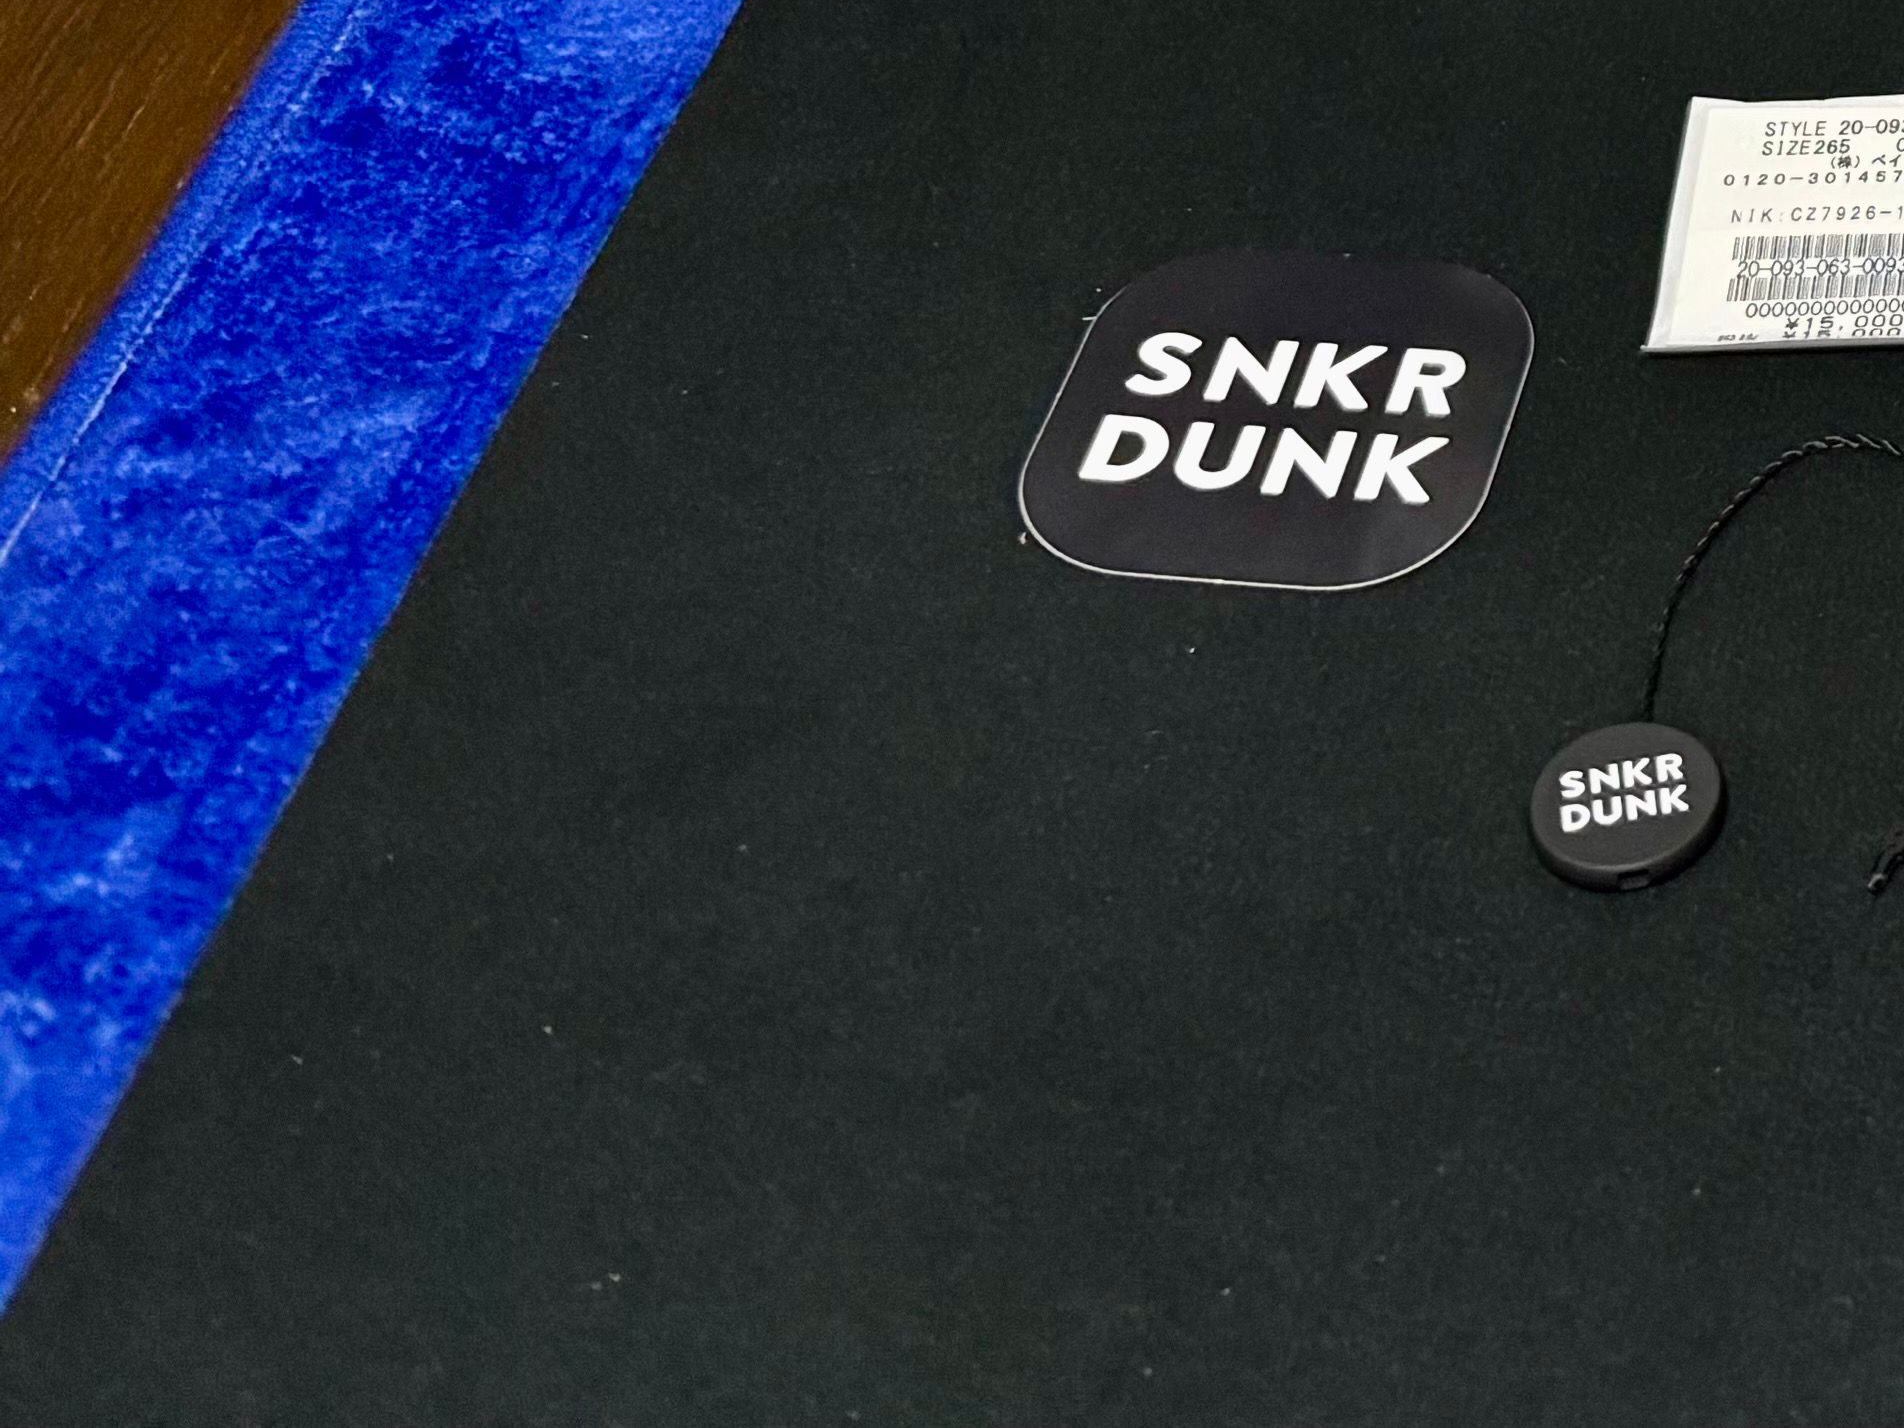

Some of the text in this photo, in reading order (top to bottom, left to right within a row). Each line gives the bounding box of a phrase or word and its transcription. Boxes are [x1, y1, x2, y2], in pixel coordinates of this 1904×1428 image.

[1765, 120, 1827, 137] STYLE
[1125, 331, 1467, 418] SNKR
[1078, 413, 1450, 505] DUNK
[1558, 752, 1684, 799] SNKR
[1559, 783, 1690, 833] DUNK
